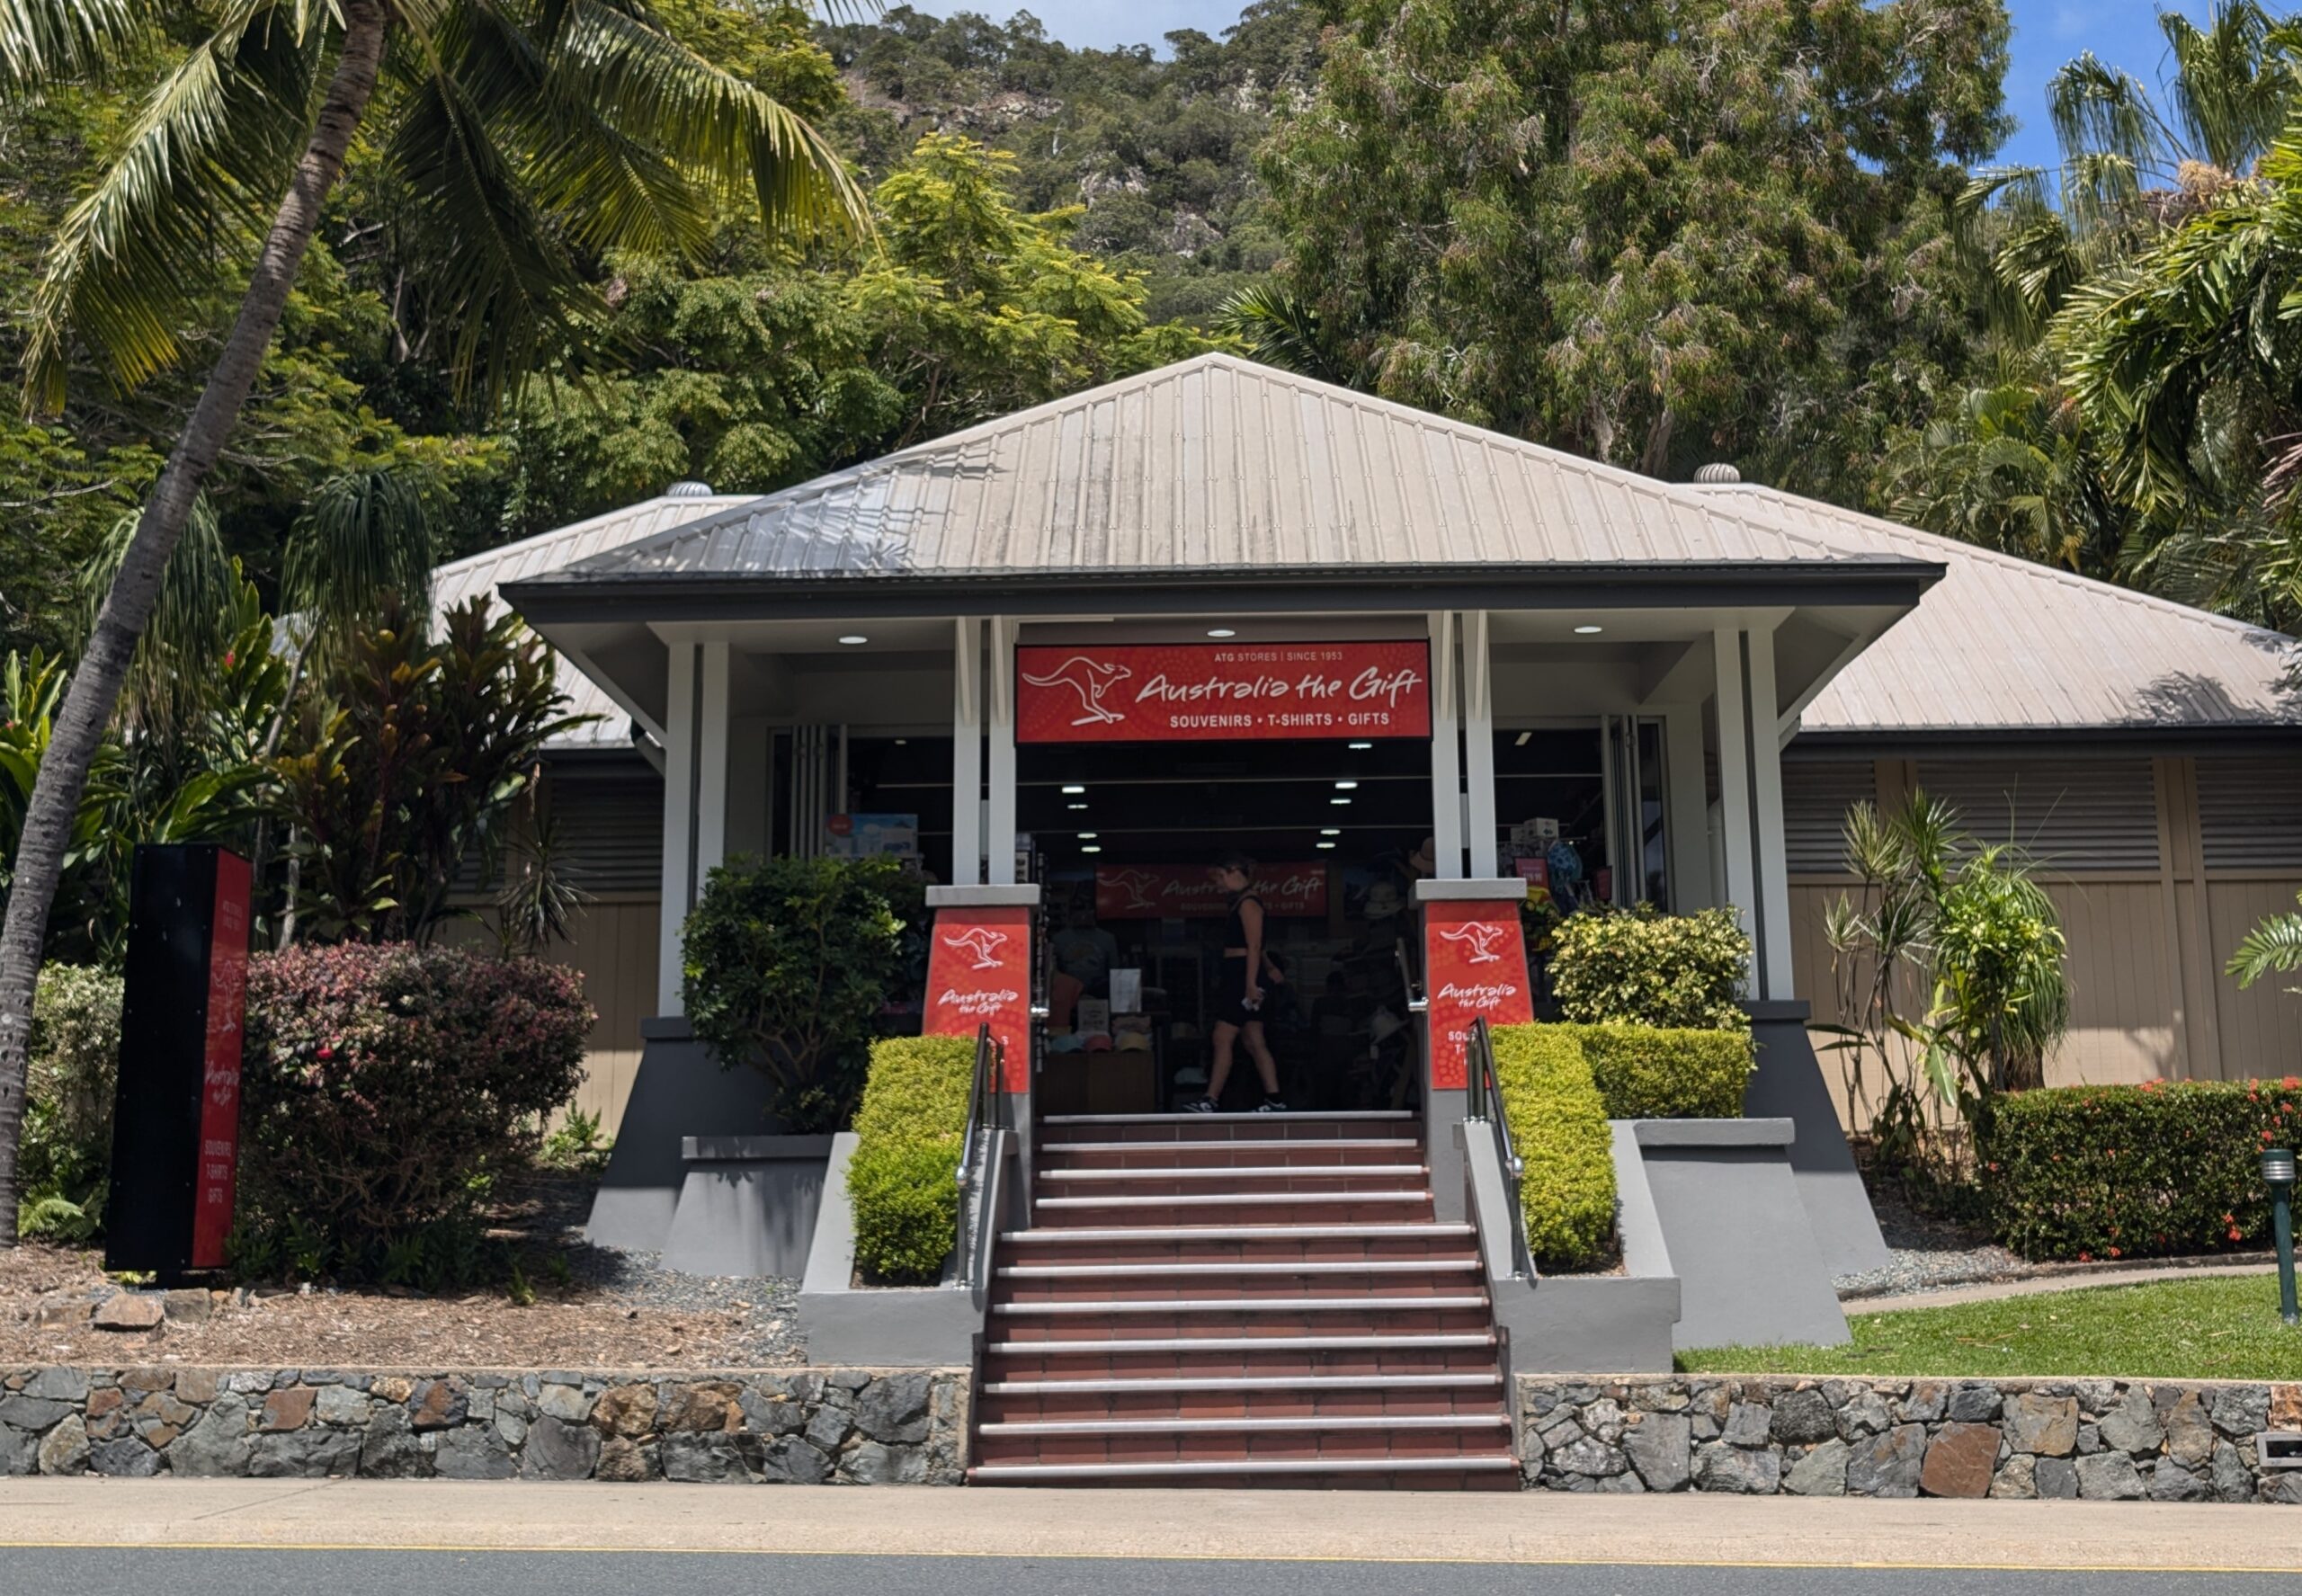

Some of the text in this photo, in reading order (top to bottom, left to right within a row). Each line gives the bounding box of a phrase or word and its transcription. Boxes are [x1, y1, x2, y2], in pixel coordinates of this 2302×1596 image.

[1214, 651, 1343, 663] ATG STORES SINCE 1953
[1135, 666, 1423, 709] Australia the Gift
[1170, 712, 1389, 728] SOUVENIRS T-SHIRTS GIFTS
[1281, 875, 1324, 900] Gift
[937, 988, 1018, 1005] Australia
[1437, 982, 1516, 999] Australia
[1476, 995, 1502, 1011] Gift
